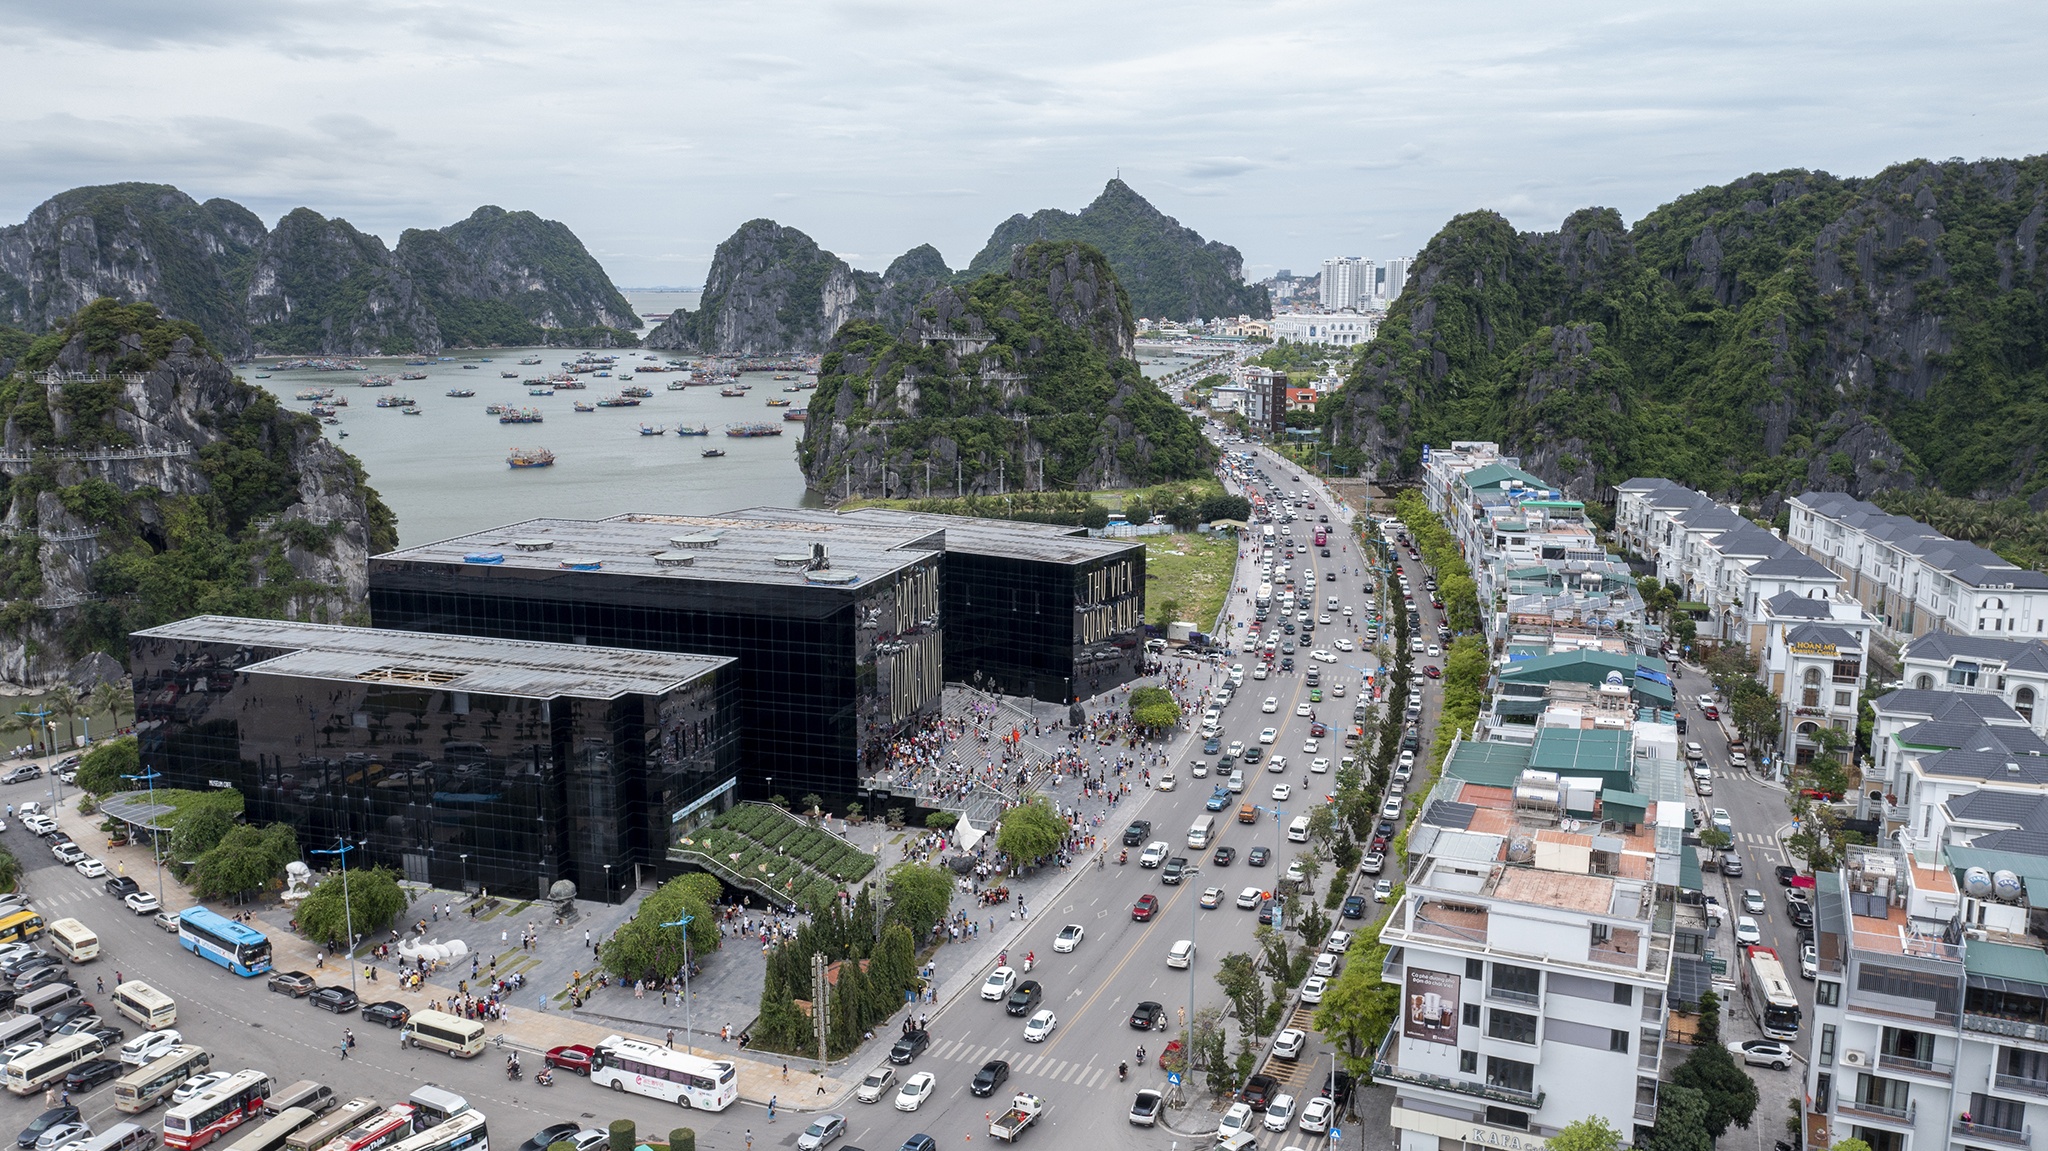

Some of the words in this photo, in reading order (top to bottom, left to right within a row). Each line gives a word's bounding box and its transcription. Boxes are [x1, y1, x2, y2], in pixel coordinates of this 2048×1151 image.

[1117, 596, 1138, 633] NINH
[1790, 646, 1815, 655] Beauty
[1797, 641, 1822, 649] HOÀN
[922, 629, 942, 704] NINH
[1473, 1128, 1521, 1150] KAFA
